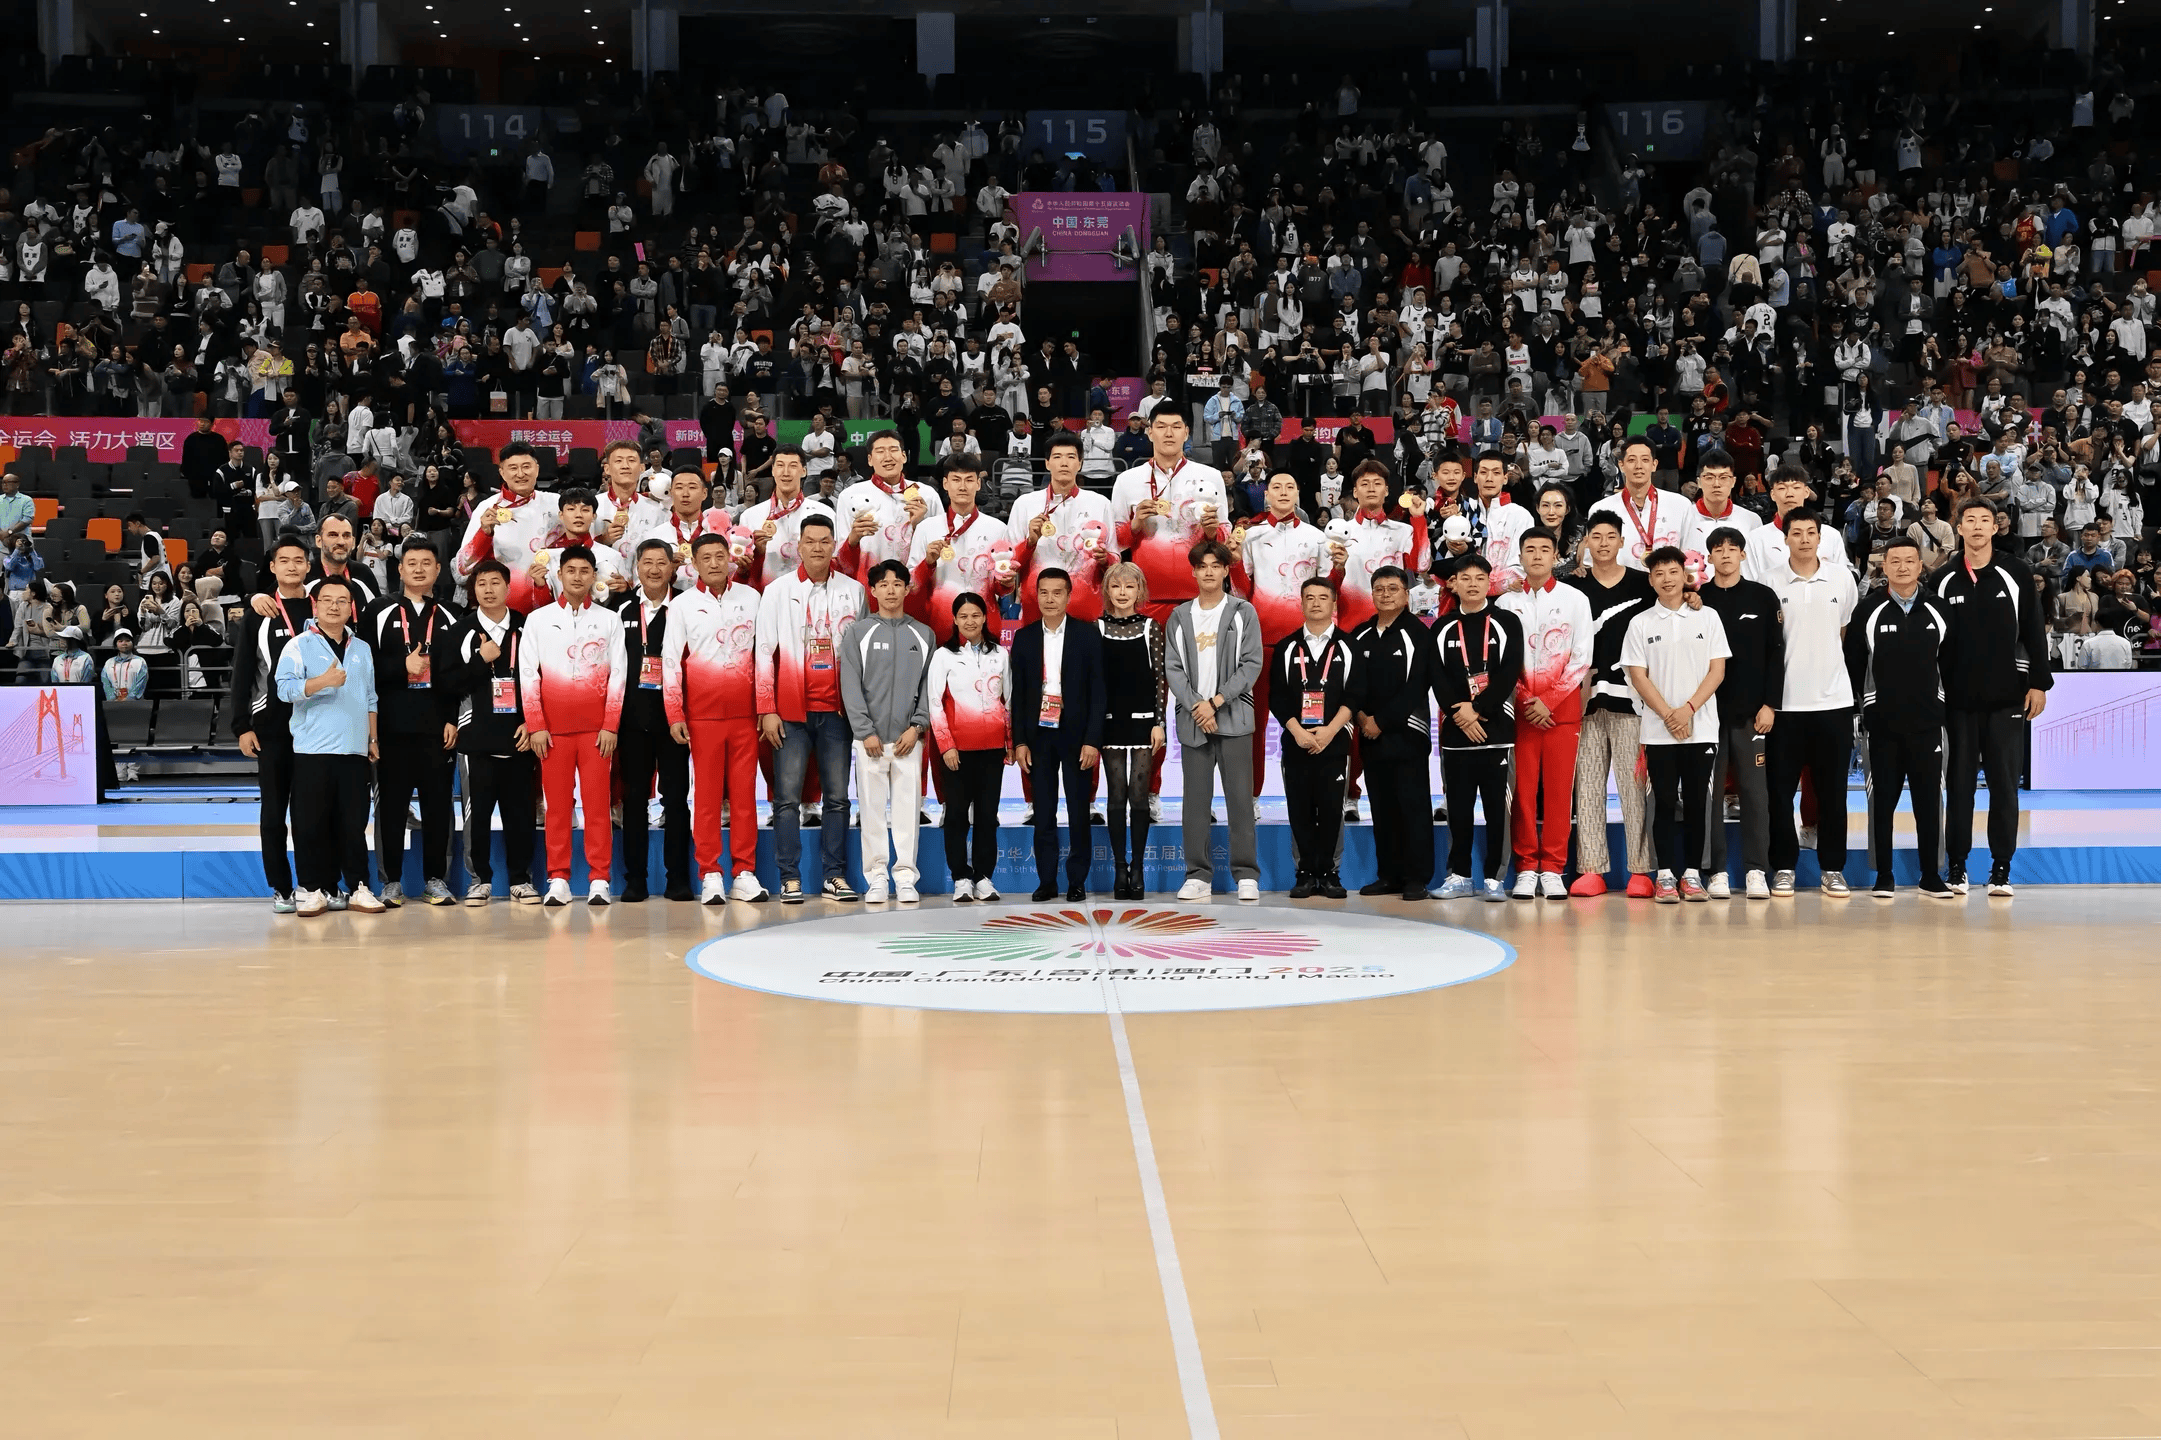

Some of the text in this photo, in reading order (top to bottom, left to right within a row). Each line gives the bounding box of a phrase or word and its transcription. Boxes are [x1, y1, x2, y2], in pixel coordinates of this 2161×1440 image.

[459, 113, 527, 139] 114
[1617, 109, 1685, 135] 116
[1041, 118, 1107, 144] 115
[1053, 216, 1108, 229] 中国·东莞
[1764, 313, 1770, 325] 2
[70, 430, 176, 450] 活力大湾区
[511, 429, 573, 442] 精彩全运会
[851, 431, 875, 446] 中
[1328, 493, 1334, 504] 3
[1268, 964, 1386, 974] 2025
